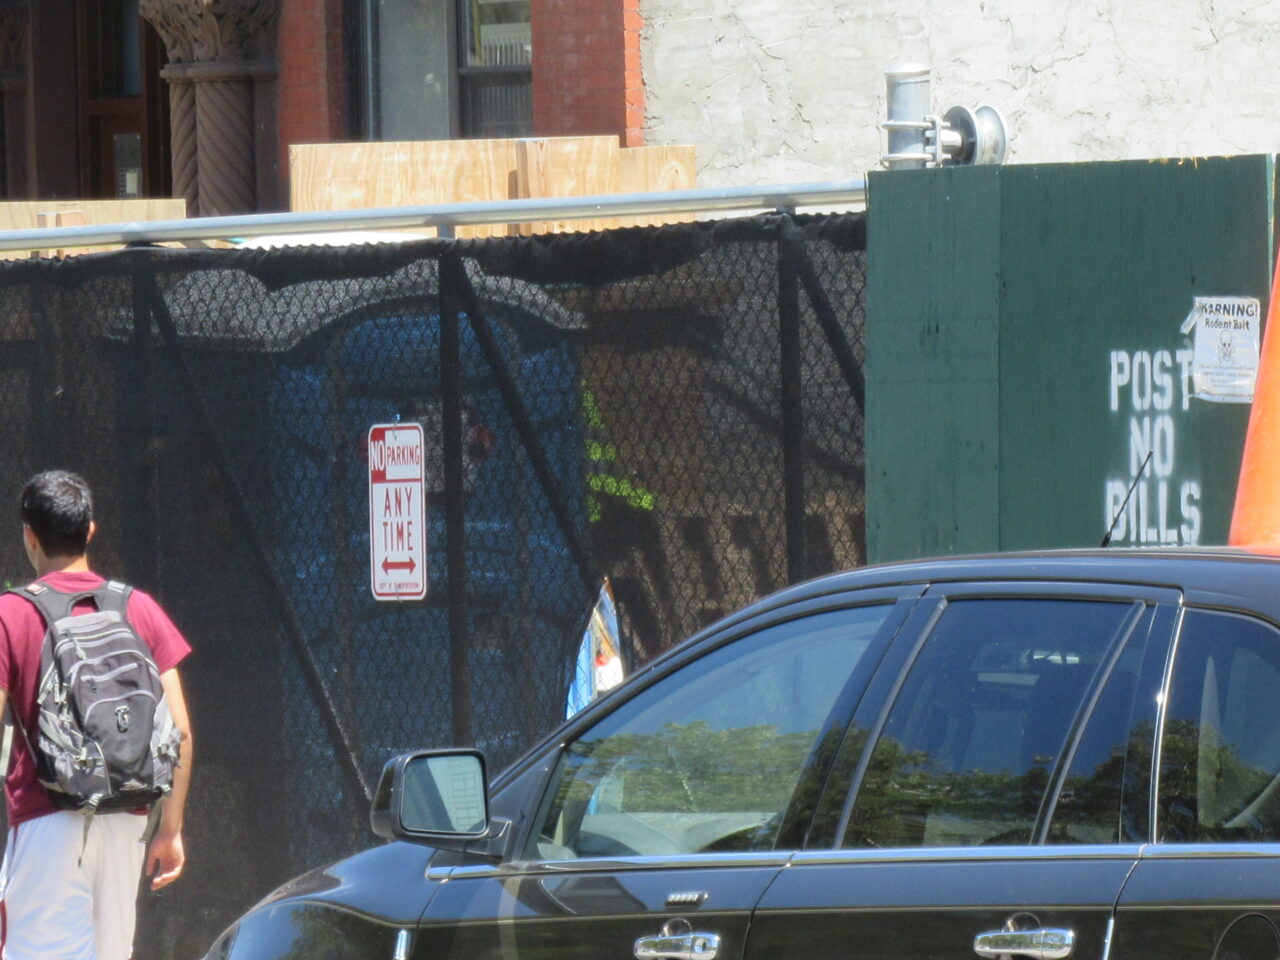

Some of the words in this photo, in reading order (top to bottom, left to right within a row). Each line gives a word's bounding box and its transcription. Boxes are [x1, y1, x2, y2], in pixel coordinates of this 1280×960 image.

[1205, 317, 1232, 329] Rodent
[1233, 320, 1250, 330] Bait
[1110, 350, 1195, 411] POST
[371, 440, 385, 471] NO
[386, 445, 420, 467] PARKING
[1130, 415, 1174, 477] NO
[384, 487, 413, 518] ANY
[1106, 480, 1200, 545] BILLS
[383, 521, 413, 551] TIME
